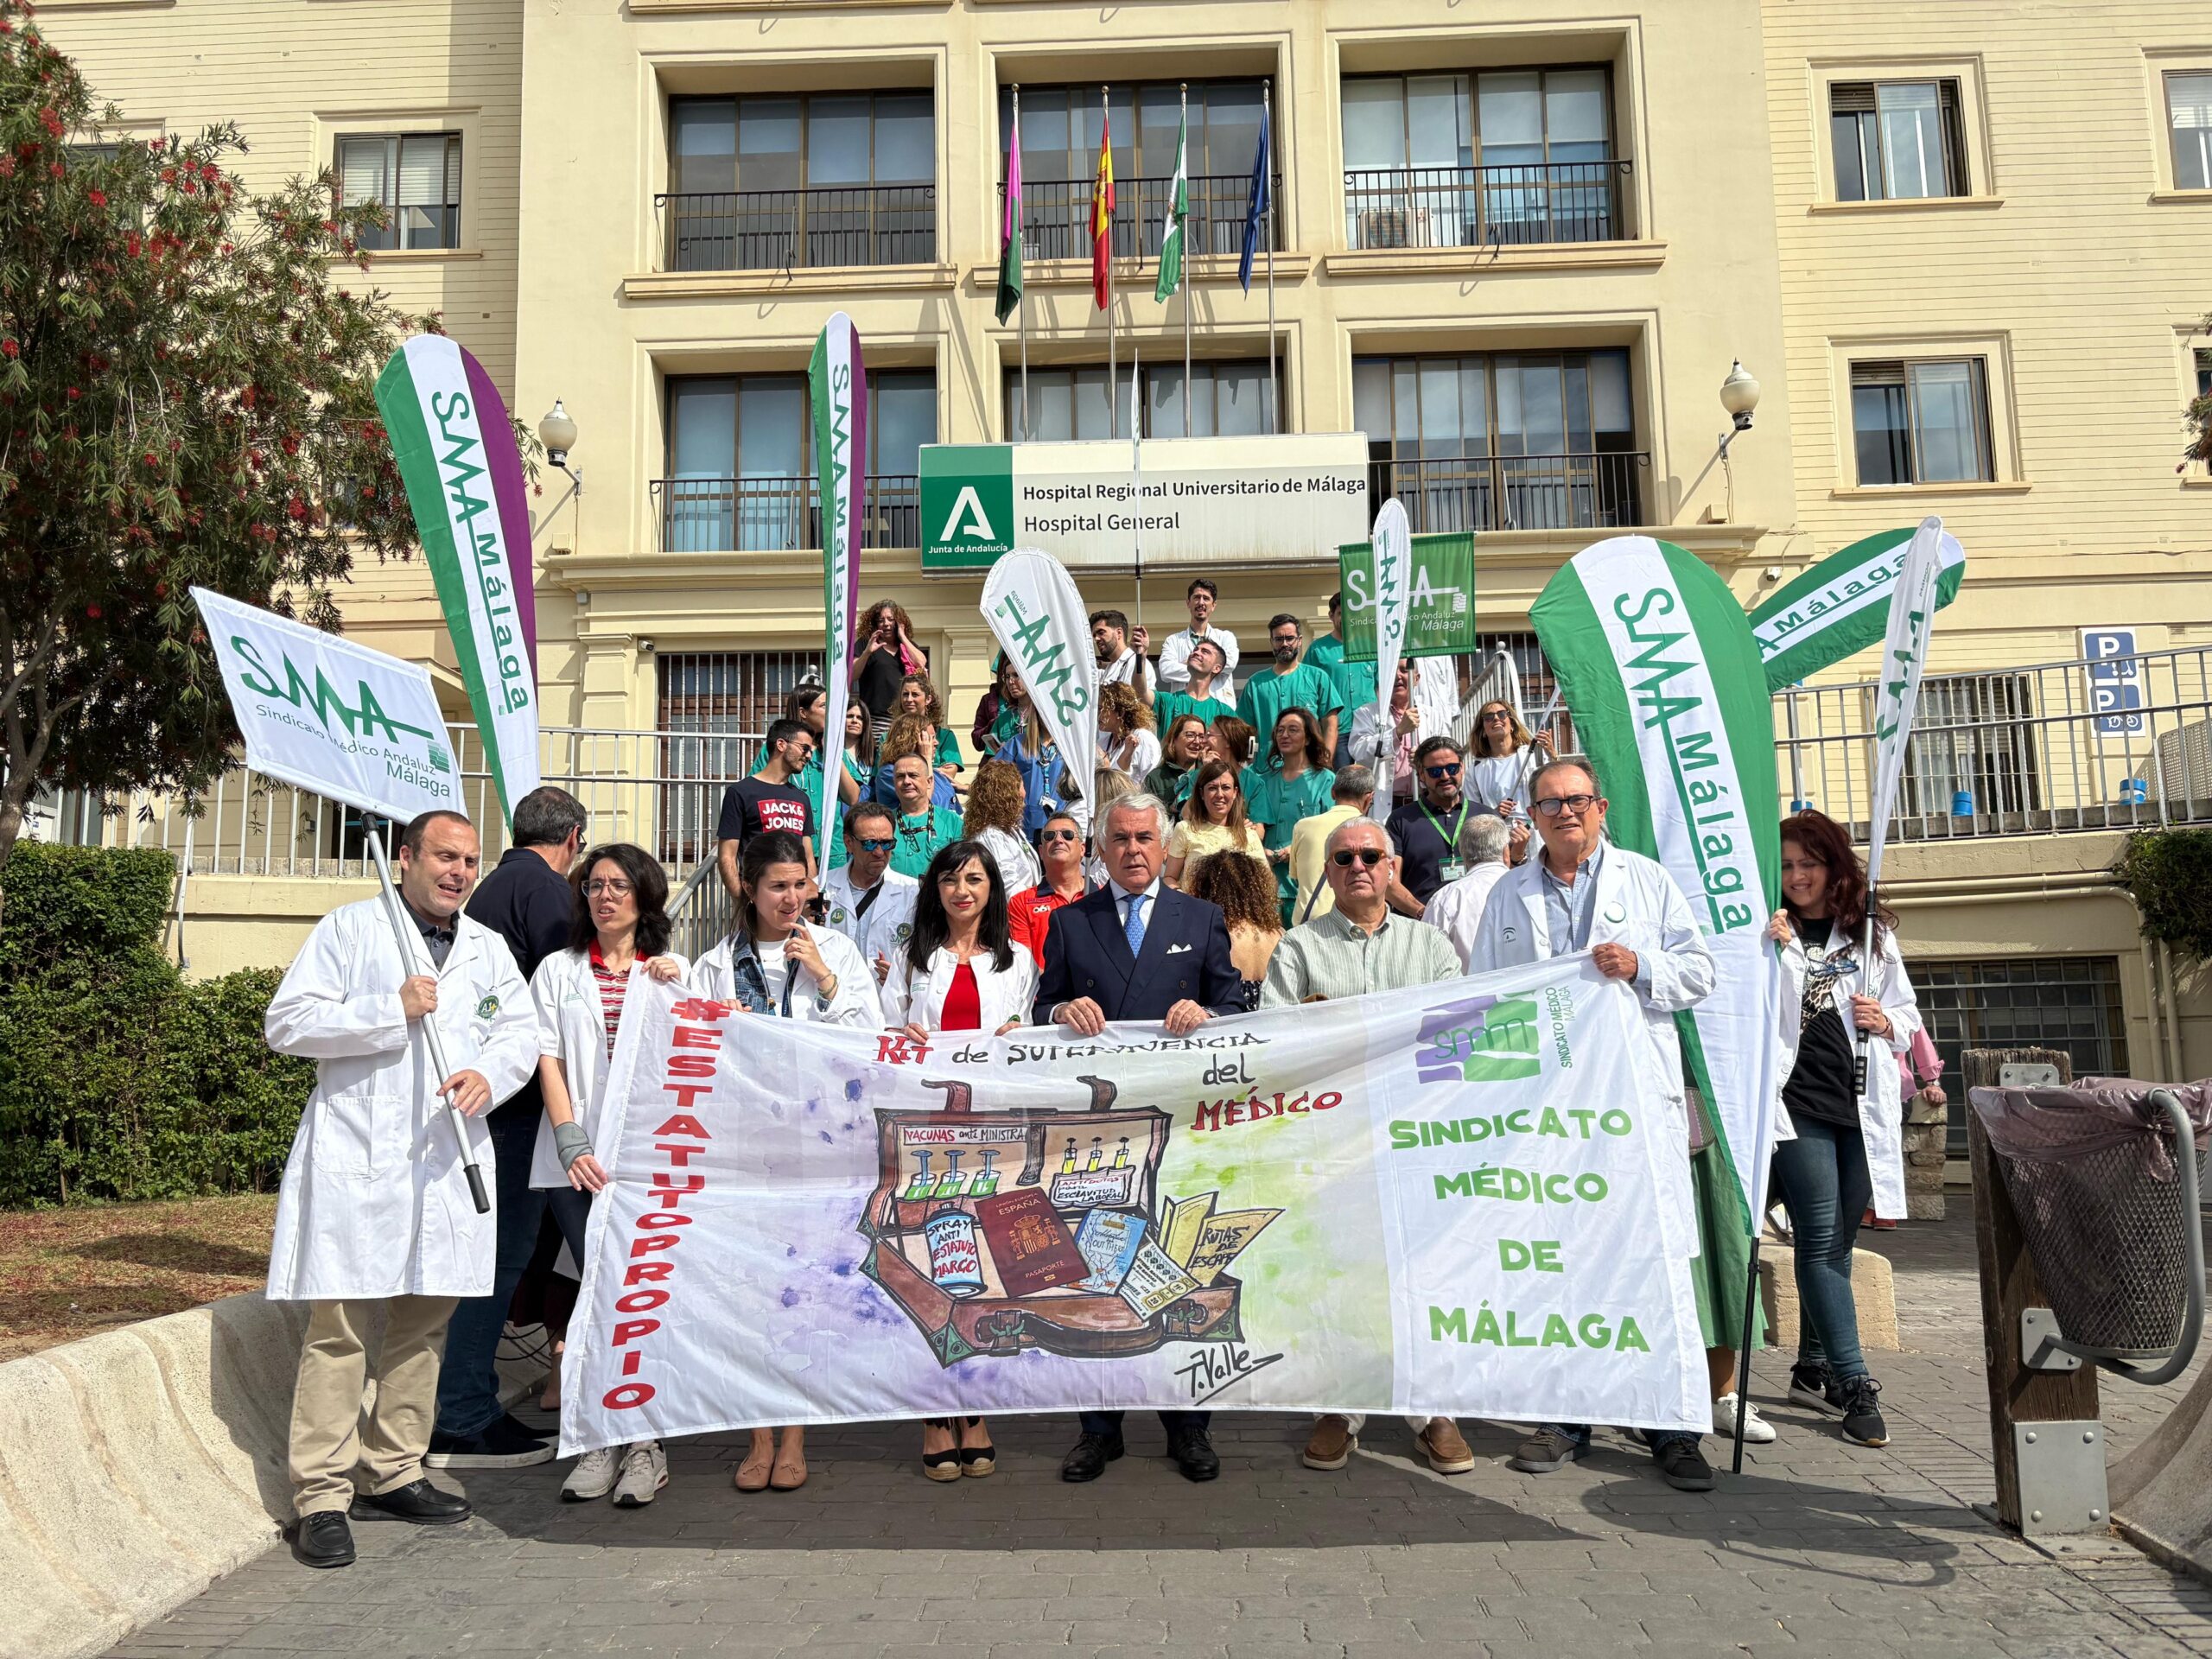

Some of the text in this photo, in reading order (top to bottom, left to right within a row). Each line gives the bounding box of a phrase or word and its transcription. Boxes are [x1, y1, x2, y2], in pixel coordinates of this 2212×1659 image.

[1023, 475, 1366, 503] Hospital Regional Universitario de Málaga
[1025, 512, 1179, 535] Hospital General
[432, 391, 529, 709] SMA Málaga
[928, 543, 1008, 554] Junta de Andalucía
[834, 497, 847, 661] Málaga
[1347, 565, 1436, 612] SA
[1350, 616, 1378, 626] Sindica
[1421, 612, 1455, 620] Andaluz
[1421, 618, 1464, 632] Málaga
[2098, 637, 2120, 665] P
[231, 635, 406, 744] SMA
[2095, 690, 2115, 717] P
[384, 747, 436, 776] Andaluz
[1613, 588, 1752, 931] SMA Málaga
[386, 760, 451, 798] Málaga
[766, 817, 804, 831] JONES
[1545, 987, 1573, 1069] SINDICATO MÉDICO
[952, 1044, 988, 1064] de
[1203, 1052, 1256, 1085] del
[1191, 1086, 1343, 1131] MÉDICO
[906, 1128, 955, 1142] VACUNAS
[979, 1127, 1025, 1141] MINISTRA
[1389, 1106, 1632, 1150] SINDICATO
[1433, 1161, 1609, 1204] MÉDICO
[998, 1198, 1041, 1216] ESPAÑA
[927, 1220, 971, 1237] SPRAY
[938, 1230, 960, 1244] ANTI
[1203, 1225, 1250, 1243] RUTAS
[933, 1239, 976, 1262] ESTATUTO
[1497, 1238, 1564, 1273] DE
[934, 1258, 977, 1278] MARCO
[1025, 1260, 1065, 1279] PASAPORTE
[1428, 1299, 1651, 1352] MÁLAGA
